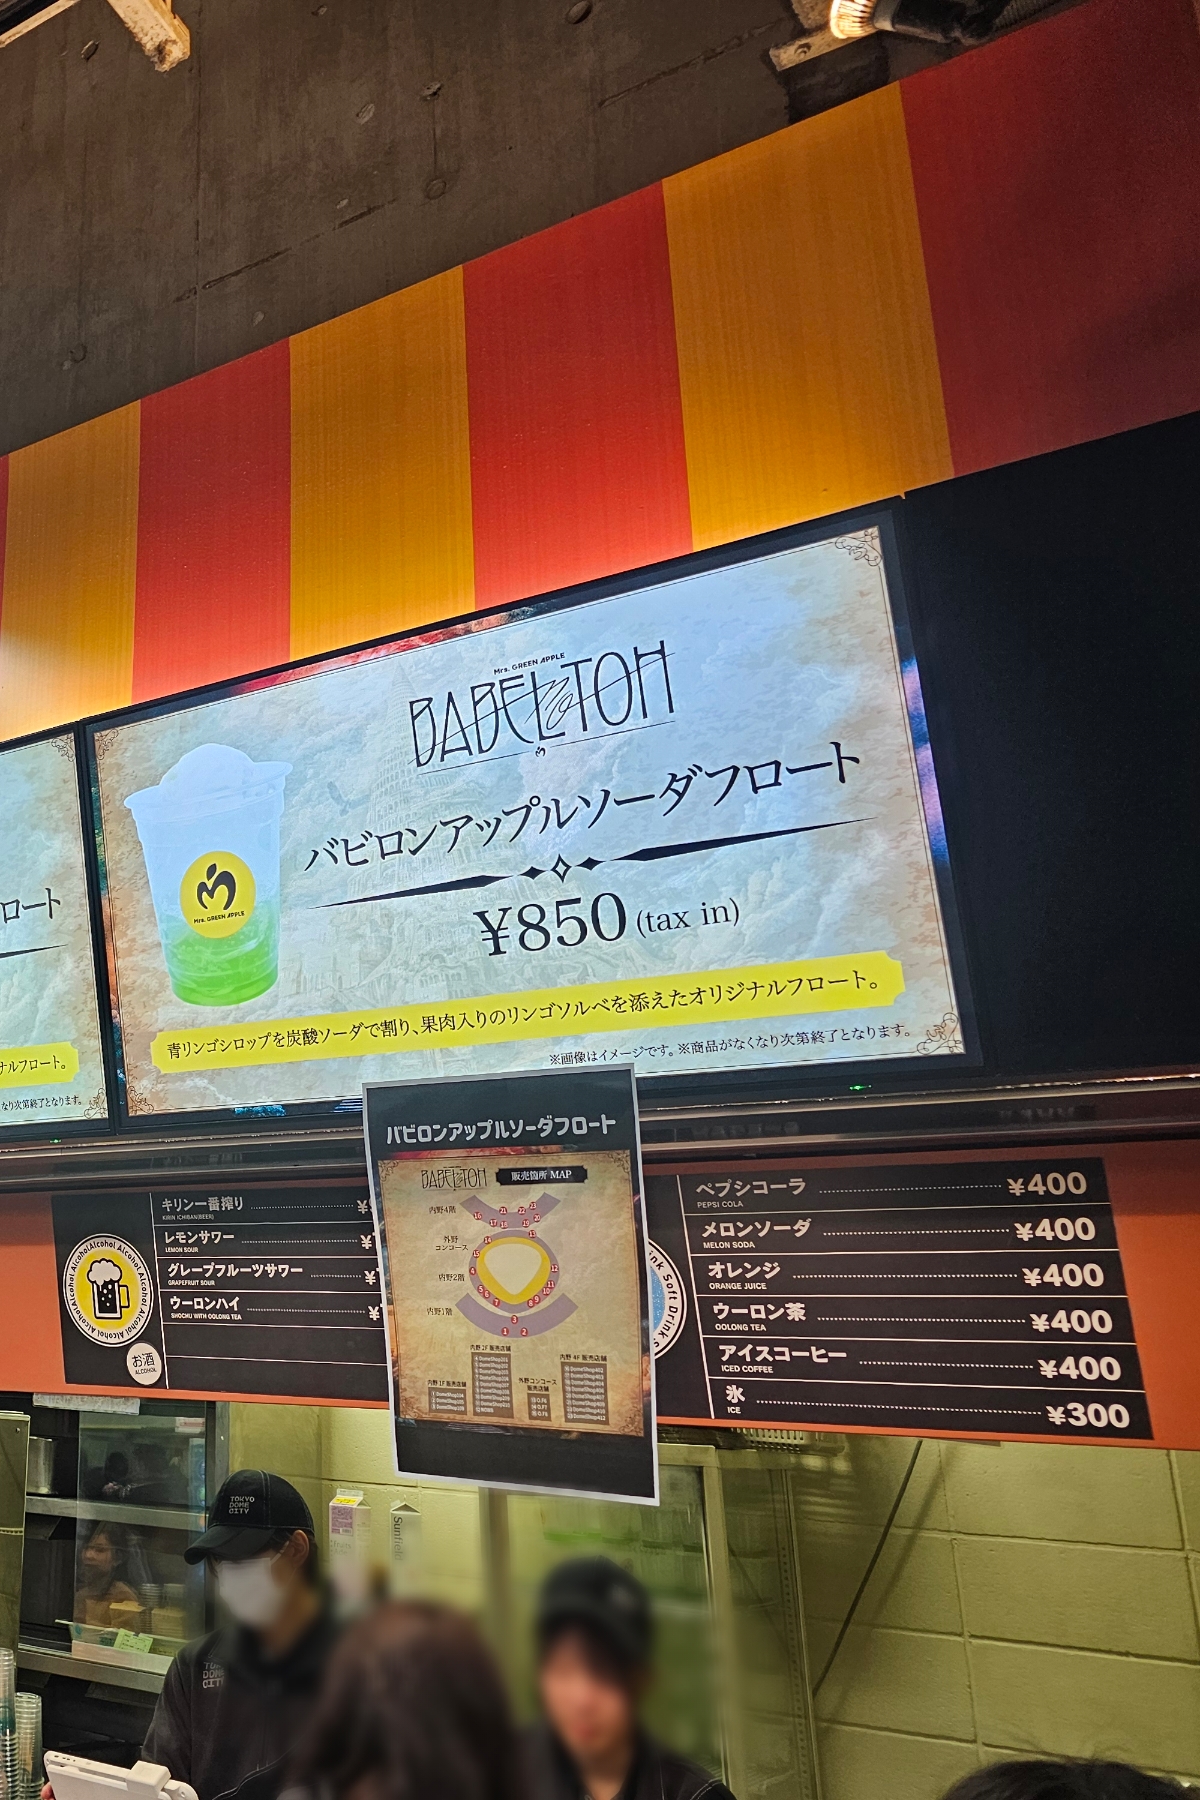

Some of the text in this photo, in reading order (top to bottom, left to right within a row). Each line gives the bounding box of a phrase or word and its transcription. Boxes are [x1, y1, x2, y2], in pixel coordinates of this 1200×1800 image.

[493, 652, 565, 675] Mrs. GREEN APPLE
[304, 741, 861, 872] バビロンアップルソーダフロート
[473, 892, 740, 957] ¥850 (tax in)
[166, 969, 878, 1059] 青リンゴシロップを炭酸ソーダで割り、果肉入りのリンゴソルベを添えたオリジナルフロート。
[386, 1113, 616, 1145] バビロンアップルソーダフロート
[550, 1169, 572, 1179] MAP
[696, 1171, 1087, 1198] ペプシコーラ ¥400
[162, 1196, 243, 1212] キリン一番搾り
[164, 1230, 234, 1244] レモンサワー
[702, 1217, 1096, 1241] メロンソーダ ¥400
[703, 1241, 730, 1249] MELON
[168, 1262, 303, 1278] グレープフルーツサワー
[708, 1261, 1104, 1287] オレンジ ¥400
[67, 1239, 148, 1340] Alcohol Alcohol Alcohol Alcohol Alcohol Alcohol Alcohol Alcohol
[709, 1282, 767, 1290] ORANGE JUICE
[170, 1296, 239, 1311] ウーロンハイ
[658, 1274, 678, 1339] Soft Drink
[713, 1302, 1113, 1334] ウーロン茶 ¥400
[715, 1323, 748, 1331] OOLONG
[132, 1352, 156, 1368] お酒
[718, 1344, 1121, 1380] アイスコーヒー ¥400
[721, 1364, 774, 1373] ICED COFFEE
[725, 1385, 1130, 1428] 氷 ¥300
[727, 1406, 741, 1414] ICE
